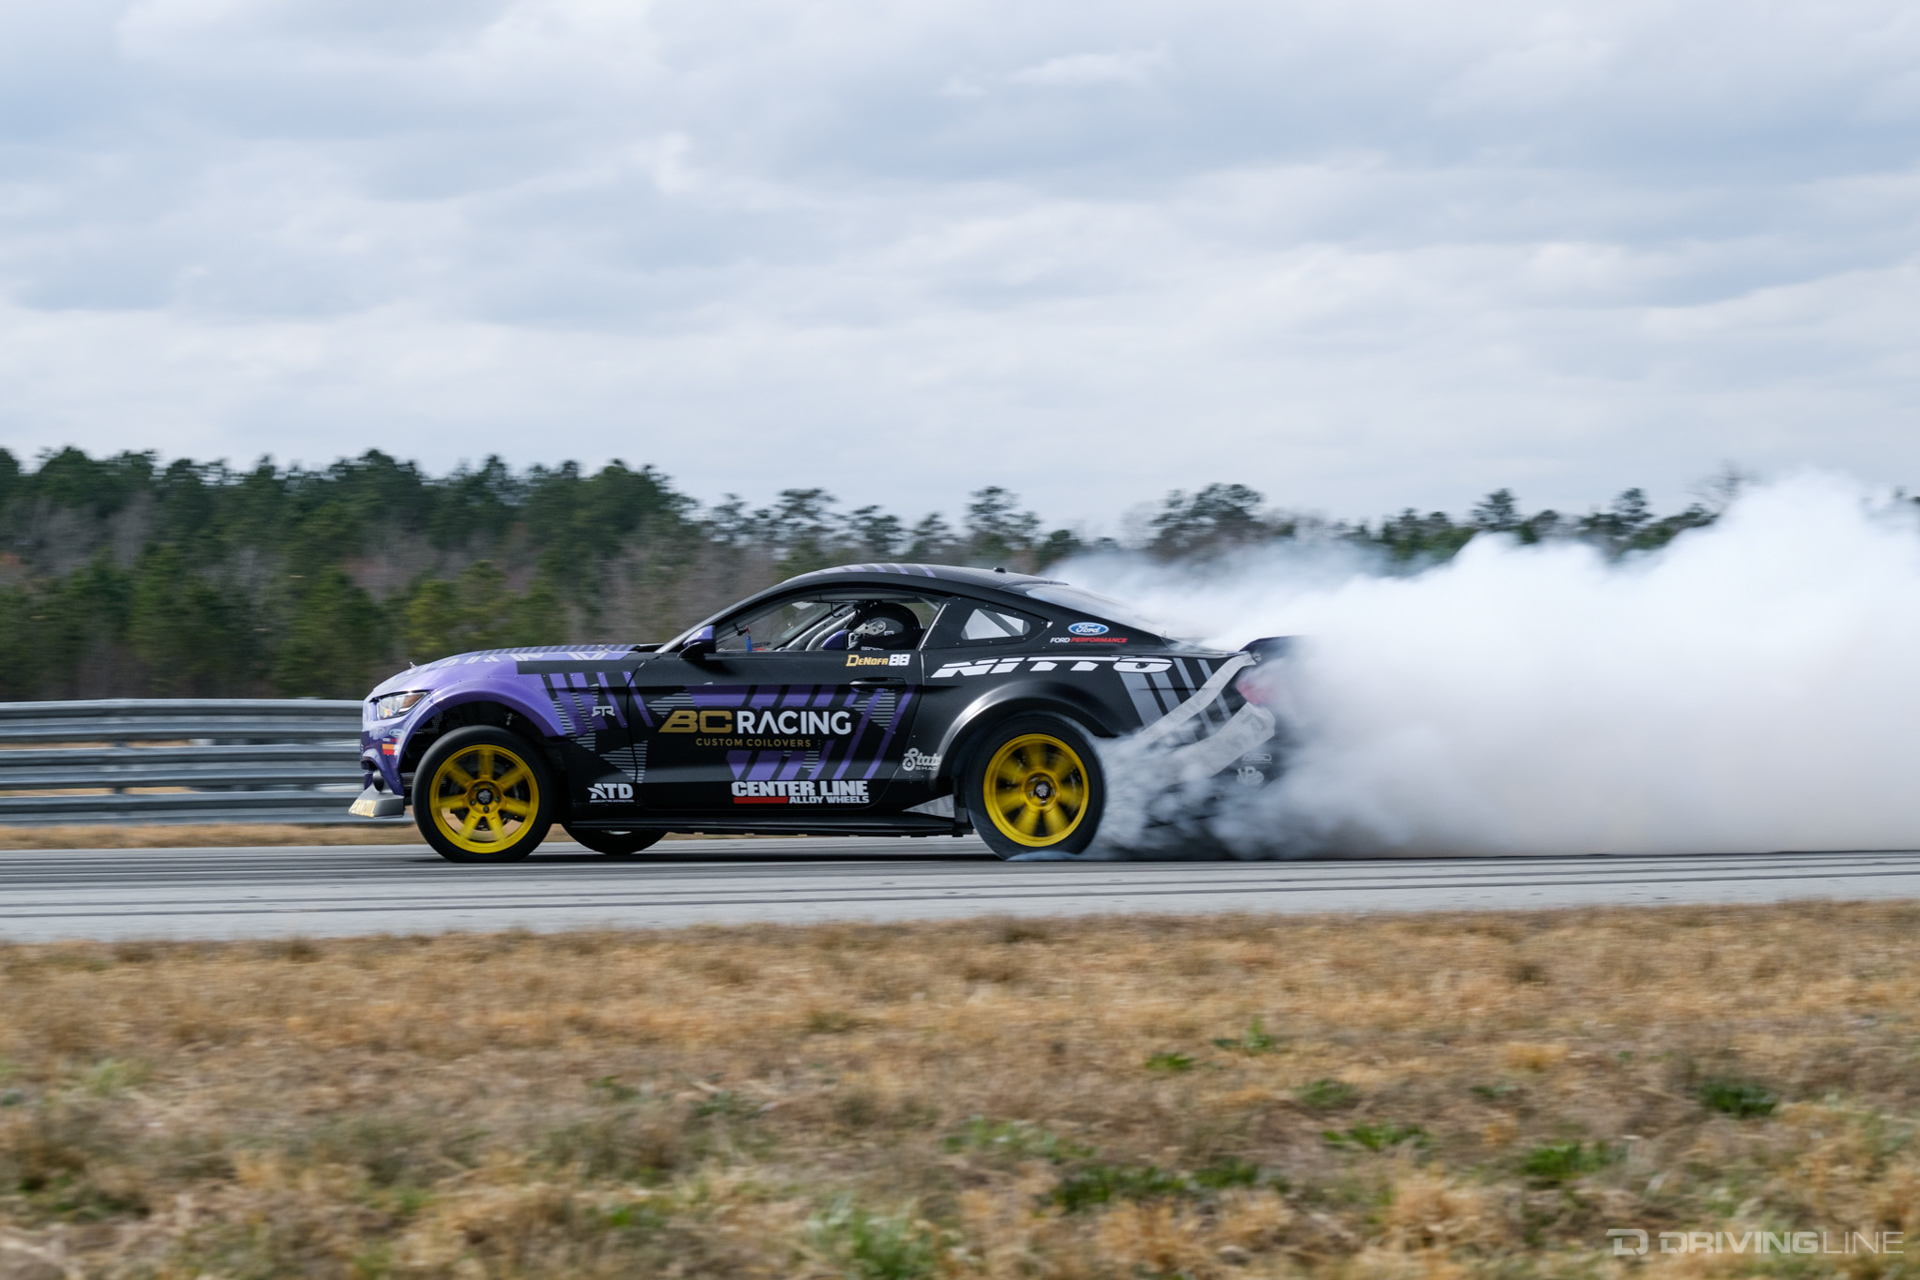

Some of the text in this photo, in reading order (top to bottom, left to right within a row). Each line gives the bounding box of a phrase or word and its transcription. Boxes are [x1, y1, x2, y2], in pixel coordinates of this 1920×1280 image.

[1075, 624, 1102, 634] Ford
[888, 653, 911, 666] 88
[930, 656, 1173, 679] NITTO
[658, 710, 852, 735] BC RACING
[695, 738, 811, 748] CUSTOM COILOVERS
[731, 780, 869, 796] CENTER LINE
[789, 796, 869, 804] ALLOY WHEELS
